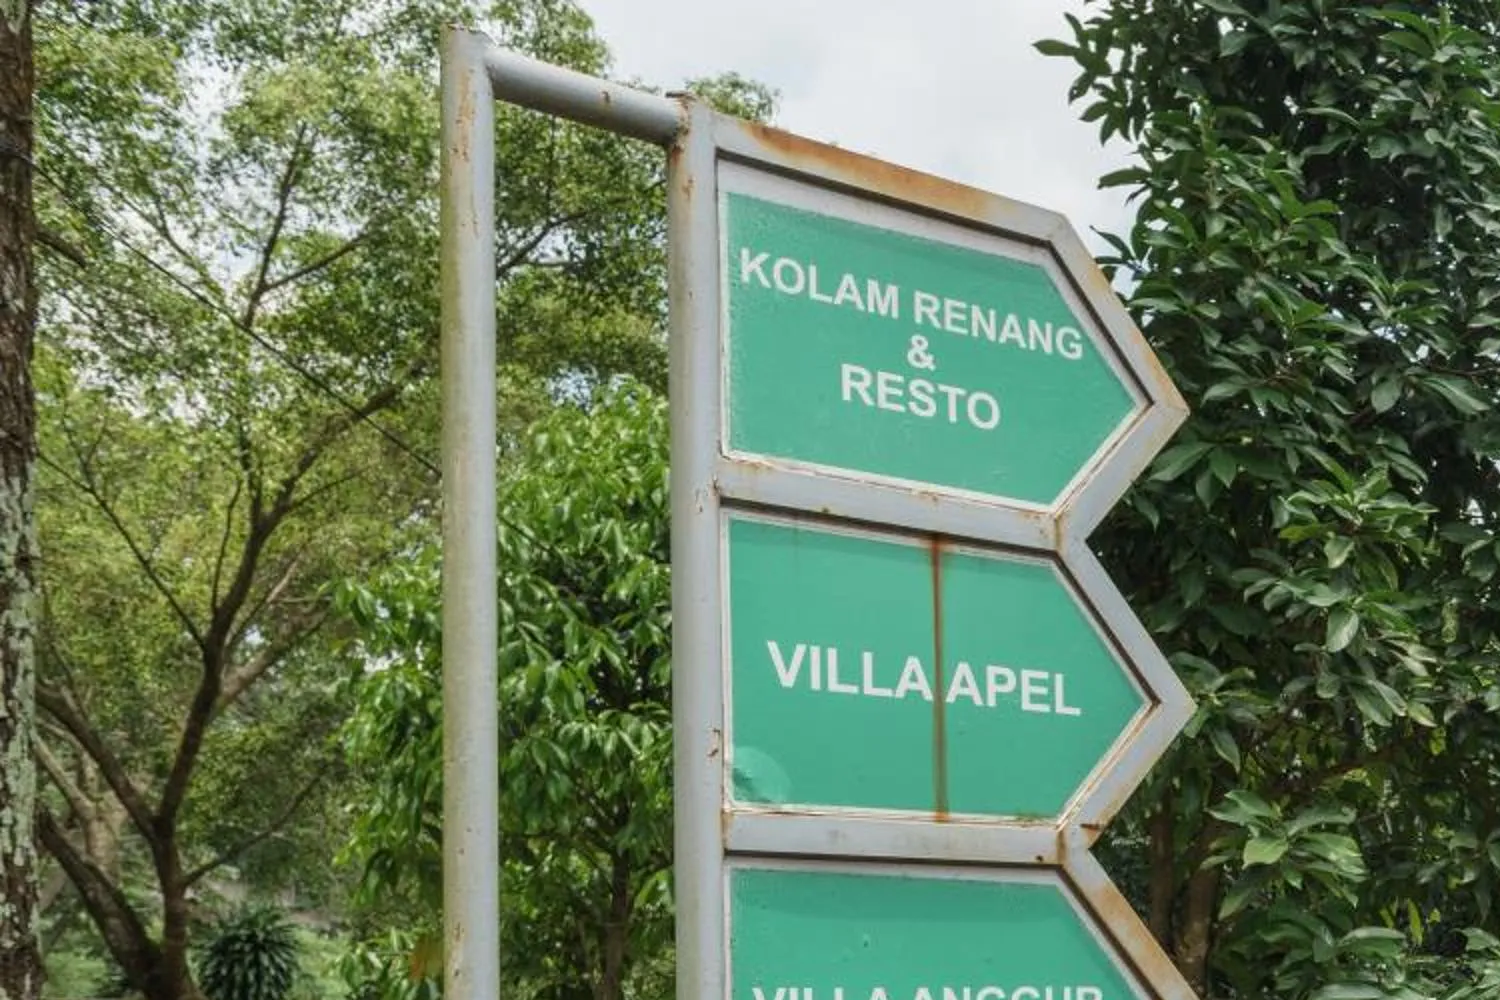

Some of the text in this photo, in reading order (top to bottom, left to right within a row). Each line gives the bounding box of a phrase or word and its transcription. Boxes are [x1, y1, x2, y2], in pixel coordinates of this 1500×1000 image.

[739, 247, 1083, 360] KOLAM RENANG
[906, 334, 935, 371] &
[841, 363, 1000, 430] RESTO
[767, 640, 1082, 716] VILLA APEL
